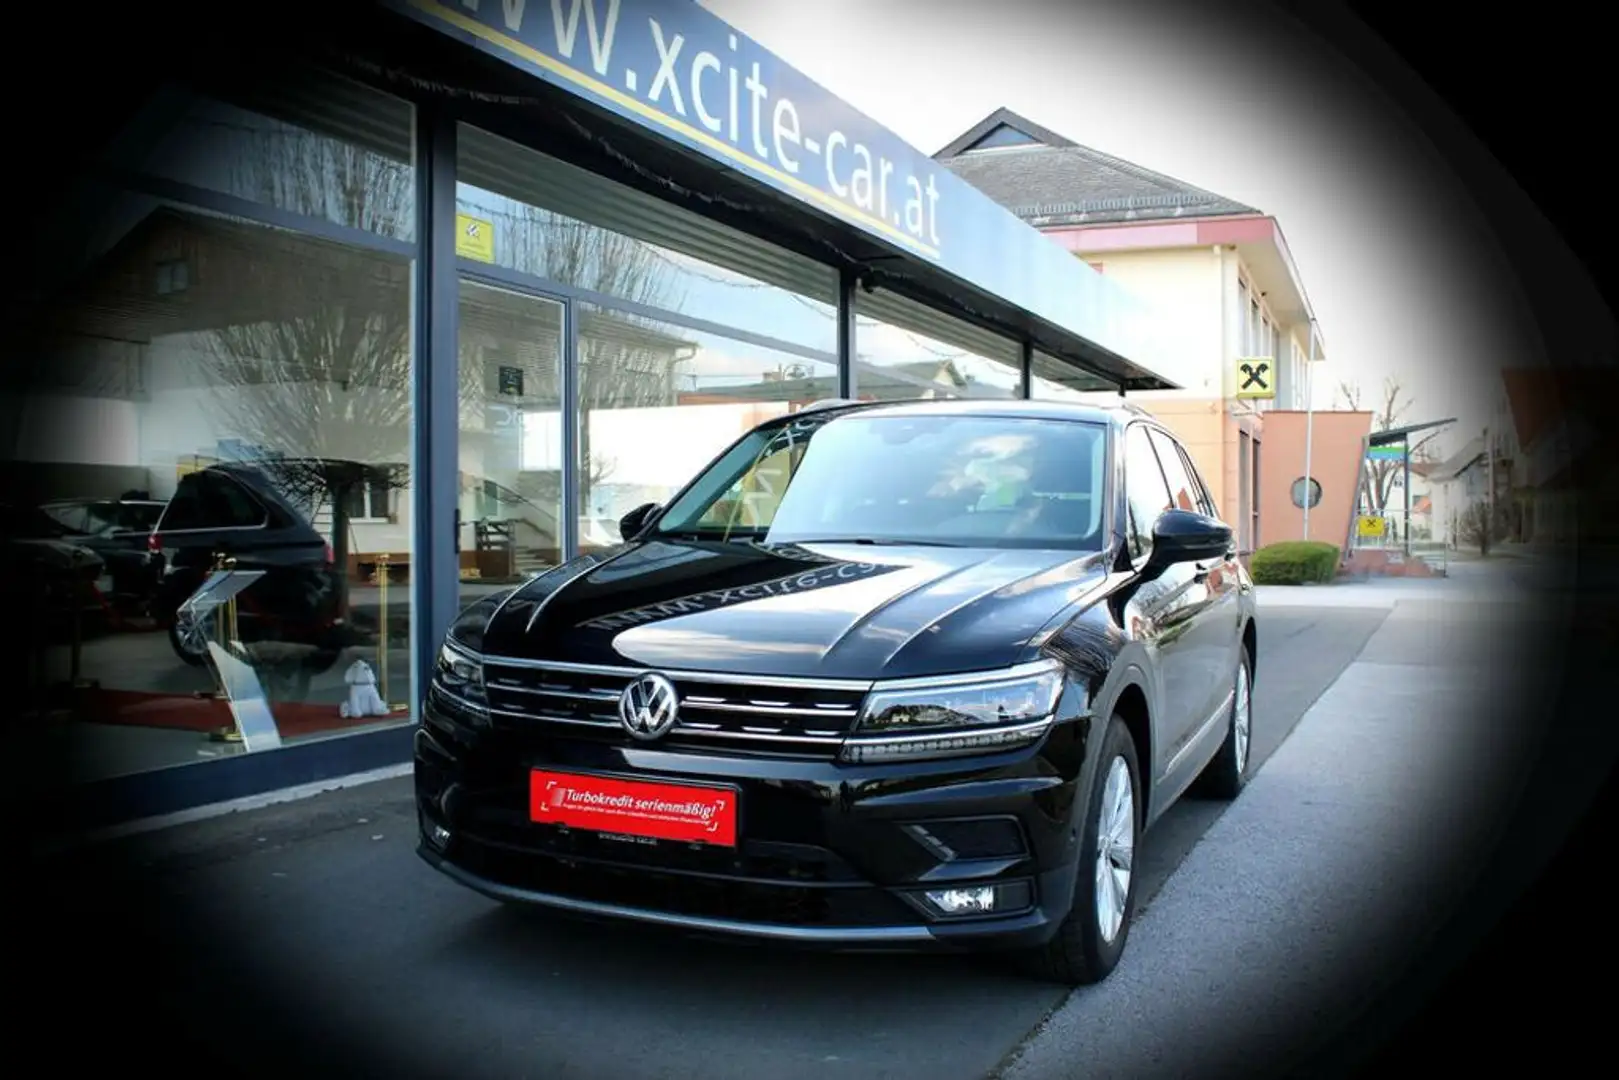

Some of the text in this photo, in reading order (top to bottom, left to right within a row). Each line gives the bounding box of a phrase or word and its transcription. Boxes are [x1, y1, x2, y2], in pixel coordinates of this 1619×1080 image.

[619, 673, 677, 739] VW
[566, 788, 634, 809] Turbokredit
[635, 798, 717, 819] serienmäßig!
